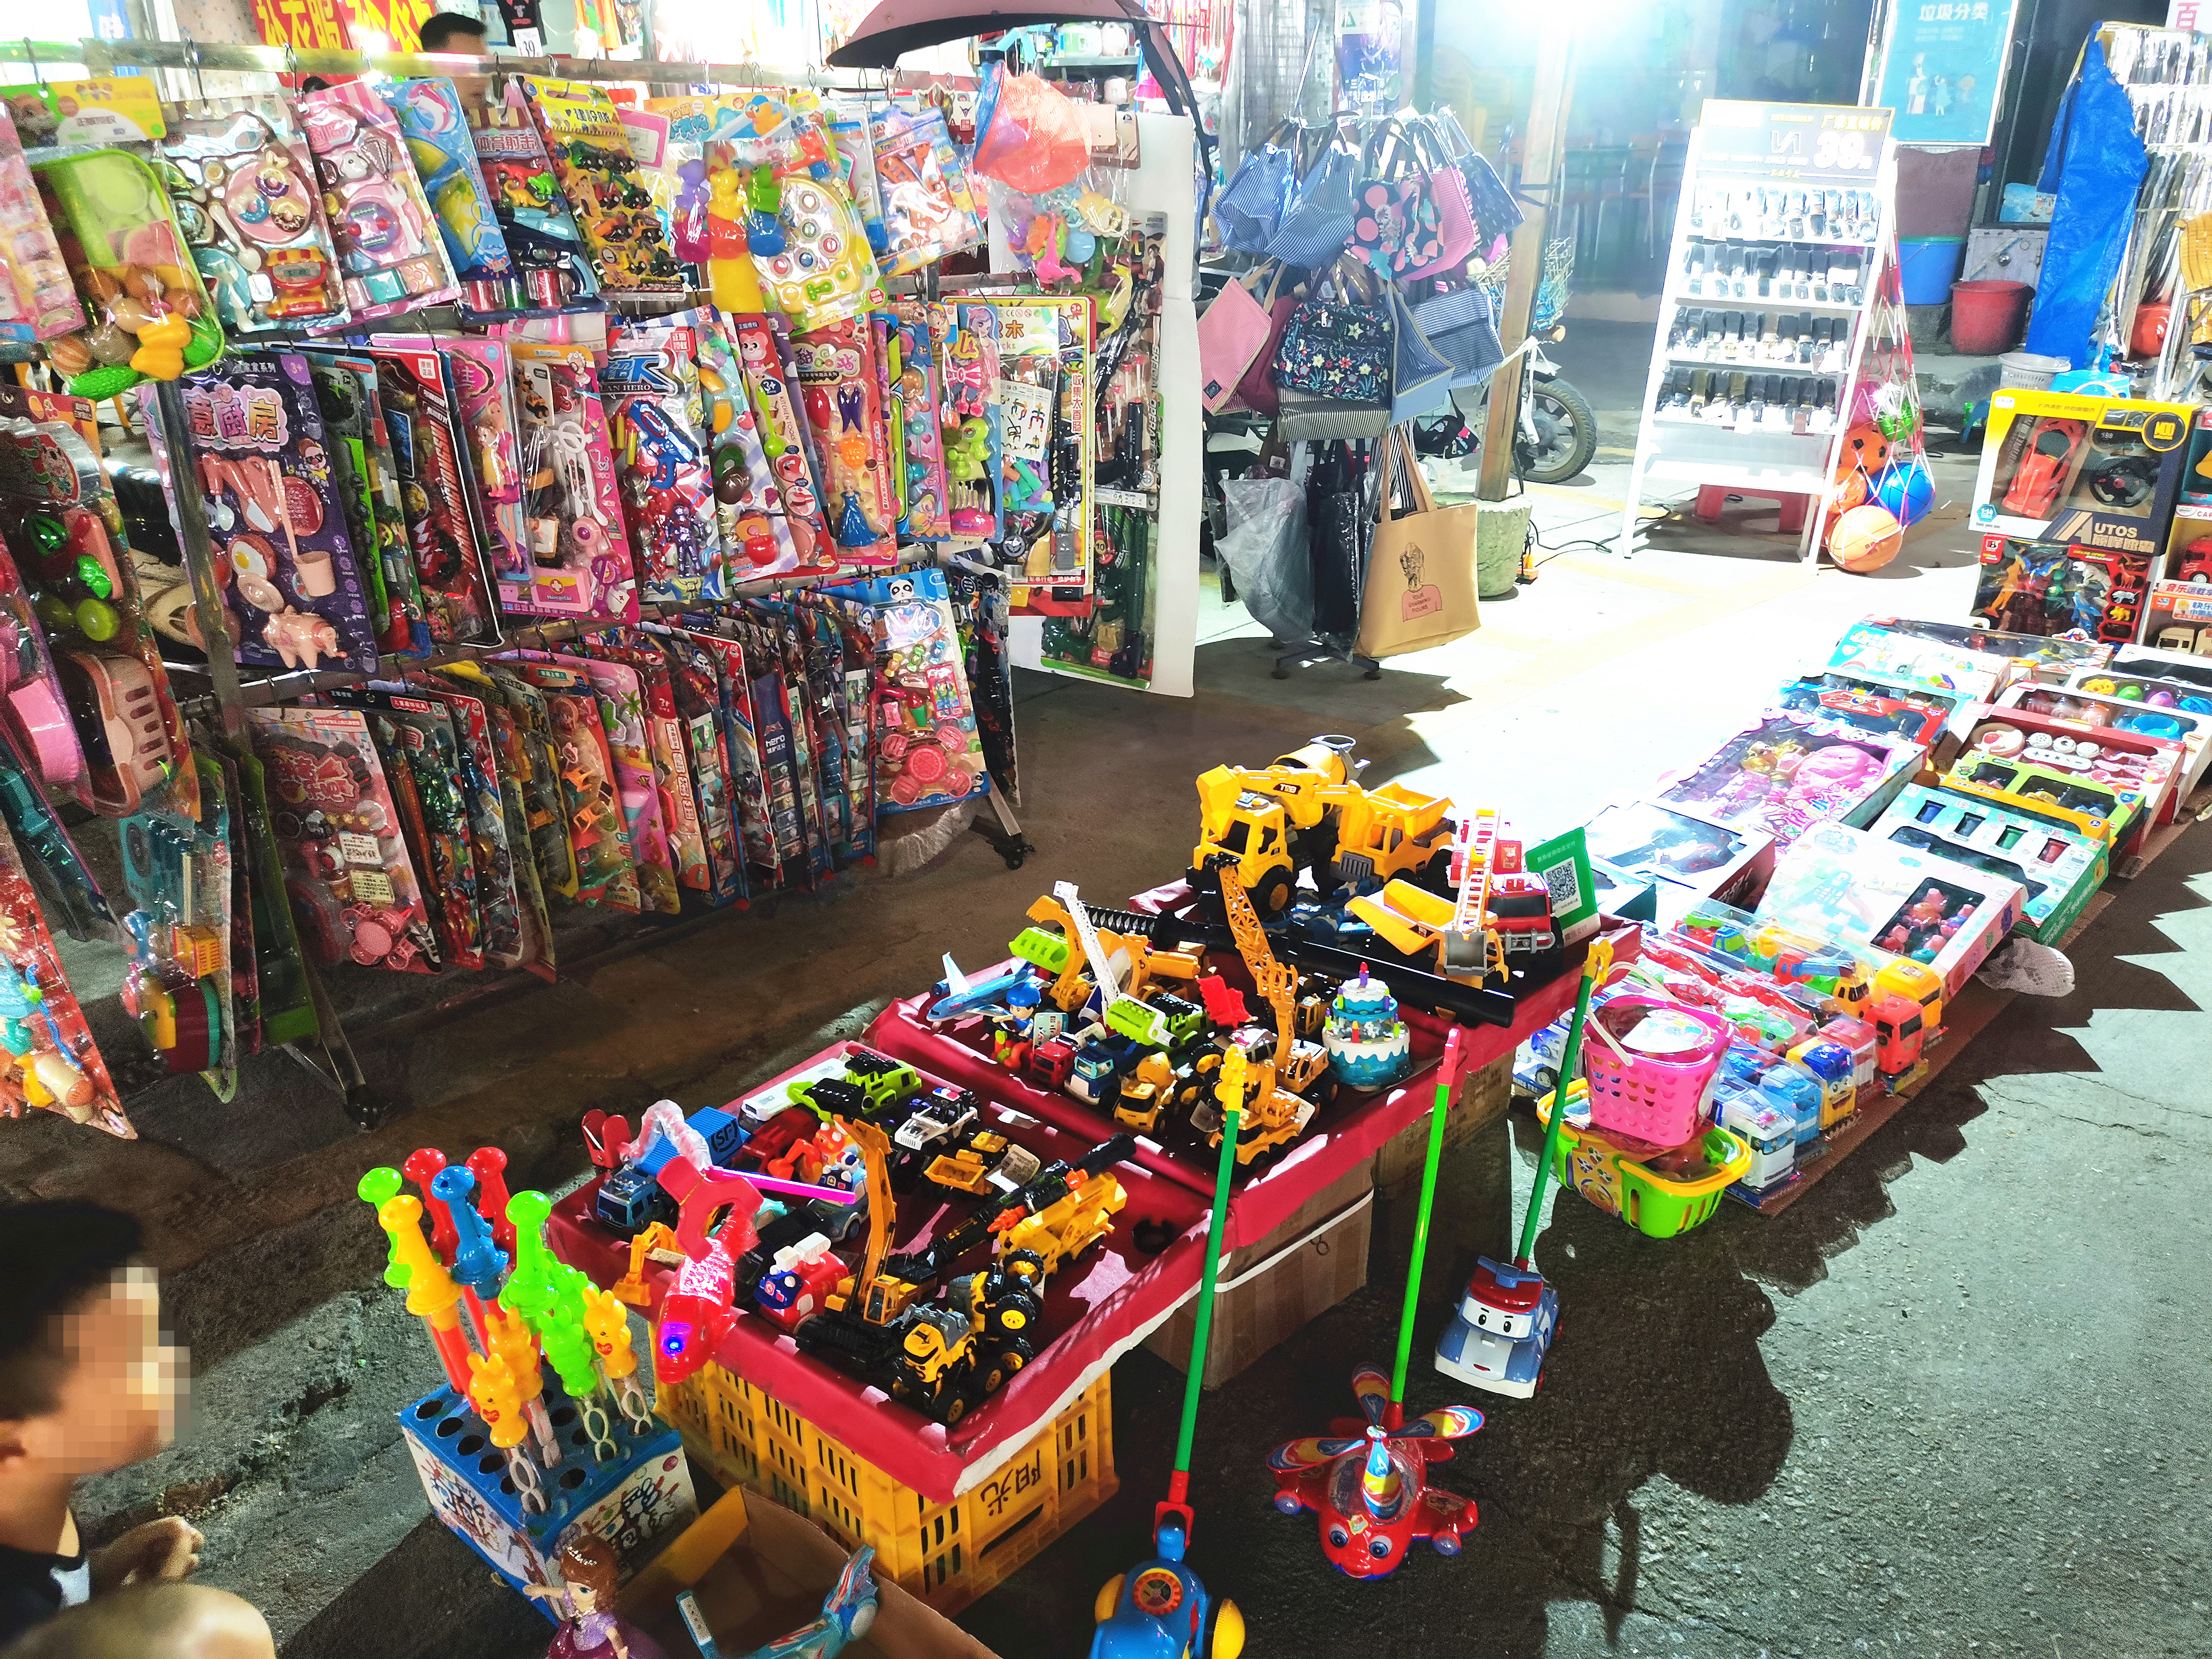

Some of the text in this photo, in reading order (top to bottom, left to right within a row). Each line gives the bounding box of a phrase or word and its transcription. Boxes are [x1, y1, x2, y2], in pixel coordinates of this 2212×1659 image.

[1919, 2, 1988, 21] 垃圾分类
[2176, 2, 2200, 30] 百
[186, 395, 278, 440] 意厨房
[779, 396, 790, 420] KITCHEN
[765, 734, 785, 748] hero
[980, 1449, 1041, 1517] 阳光
